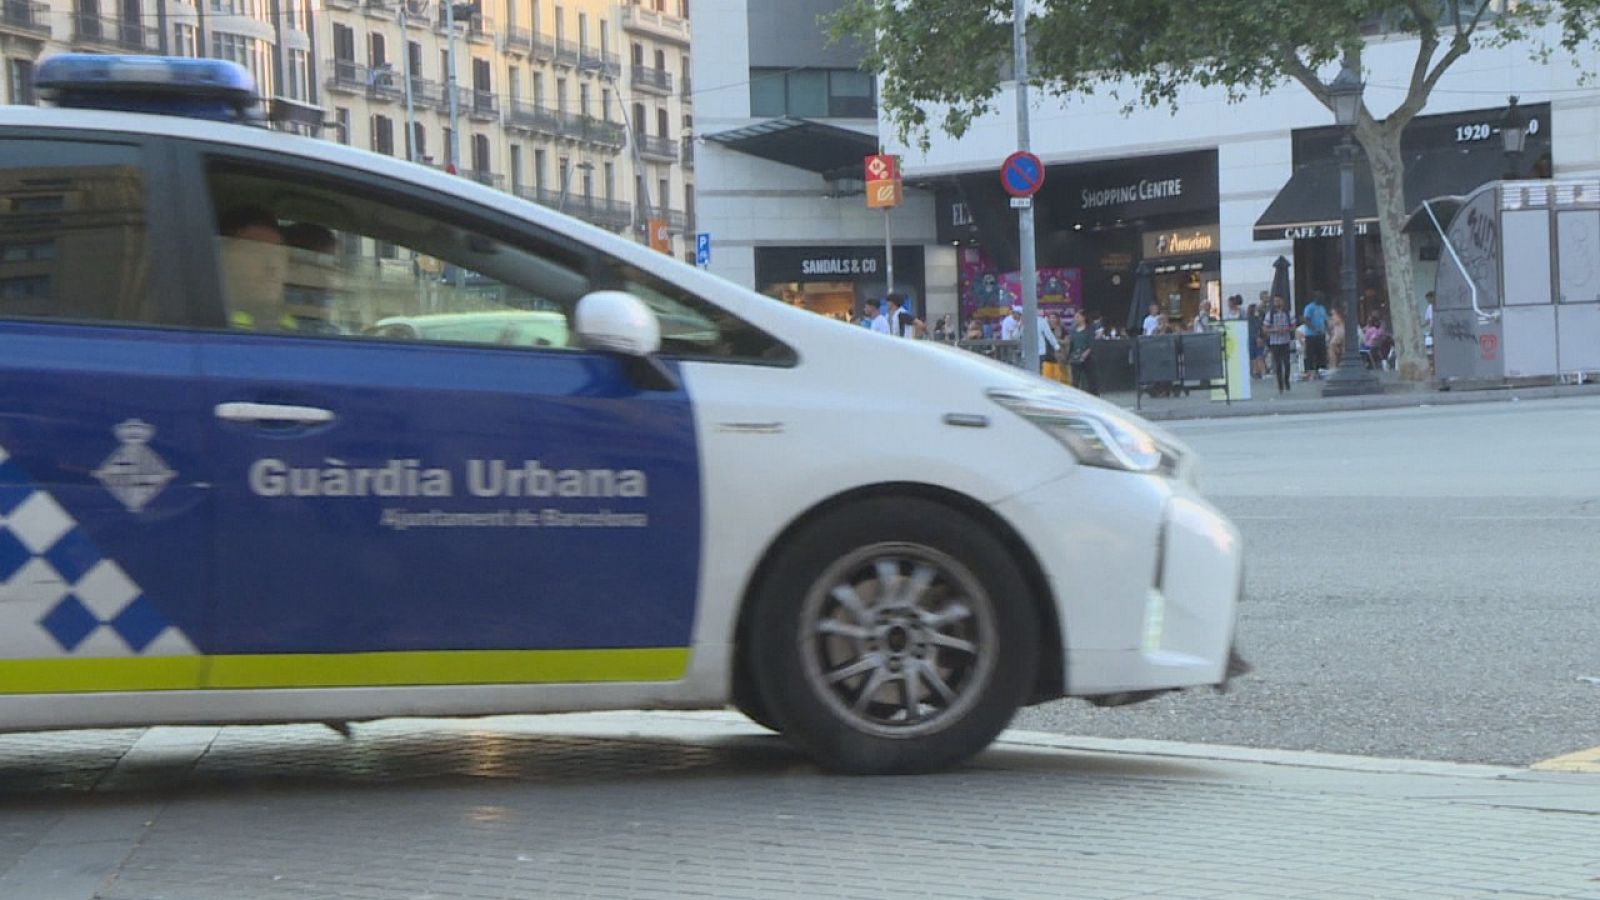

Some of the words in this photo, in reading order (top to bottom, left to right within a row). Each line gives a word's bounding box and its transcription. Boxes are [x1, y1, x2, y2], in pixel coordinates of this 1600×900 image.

[1456, 123, 1490, 141] 1920
[802, 259, 850, 274] SANDALS
[851, 259, 860, 273] &
[862, 259, 876, 273] CO
[249, 457, 452, 497] Guàrdia
[466, 459, 648, 497] Urbana
